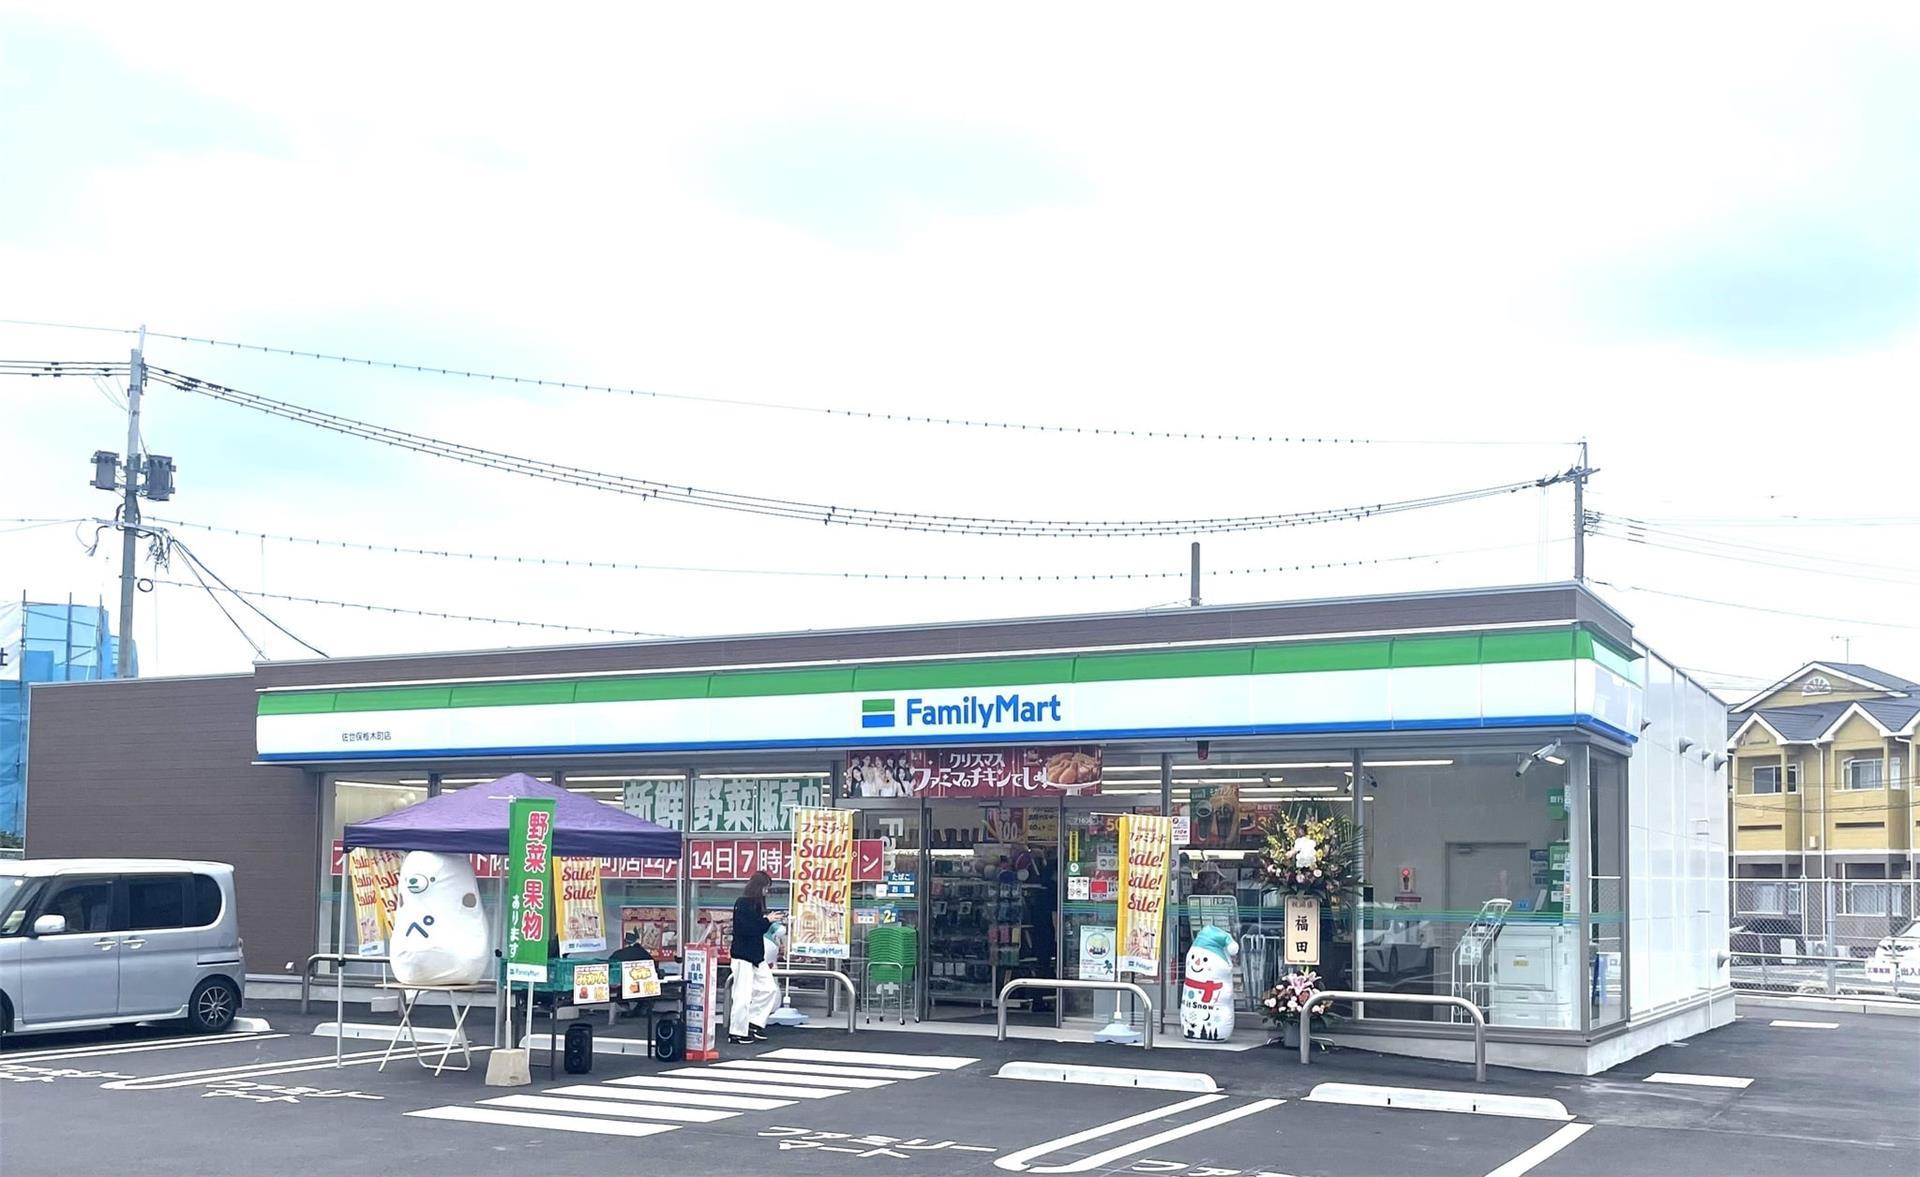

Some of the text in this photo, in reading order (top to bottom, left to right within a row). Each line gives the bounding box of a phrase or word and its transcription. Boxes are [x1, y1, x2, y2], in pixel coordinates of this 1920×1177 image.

[907, 695, 1061, 728] FamilyMart
[949, 753, 1005, 768] クリスマス
[800, 838, 848, 859] Sale!
[522, 811, 550, 943] 野菜 果物
[562, 867, 596, 882] Sale!
[798, 860, 848, 881] Sale!
[892, 872, 911, 881] たばこ
[563, 885, 597, 901] Sale!
[797, 882, 847, 905] Sale!
[508, 894, 521, 959] あります
[1295, 915, 1309, 953] 福田
[808, 946, 843, 957] FamilyMart
[1192, 1002, 1214, 1010] Snow
[757, 1125, 998, 1152] ファミリー
[778, 1138, 911, 1159] マート
